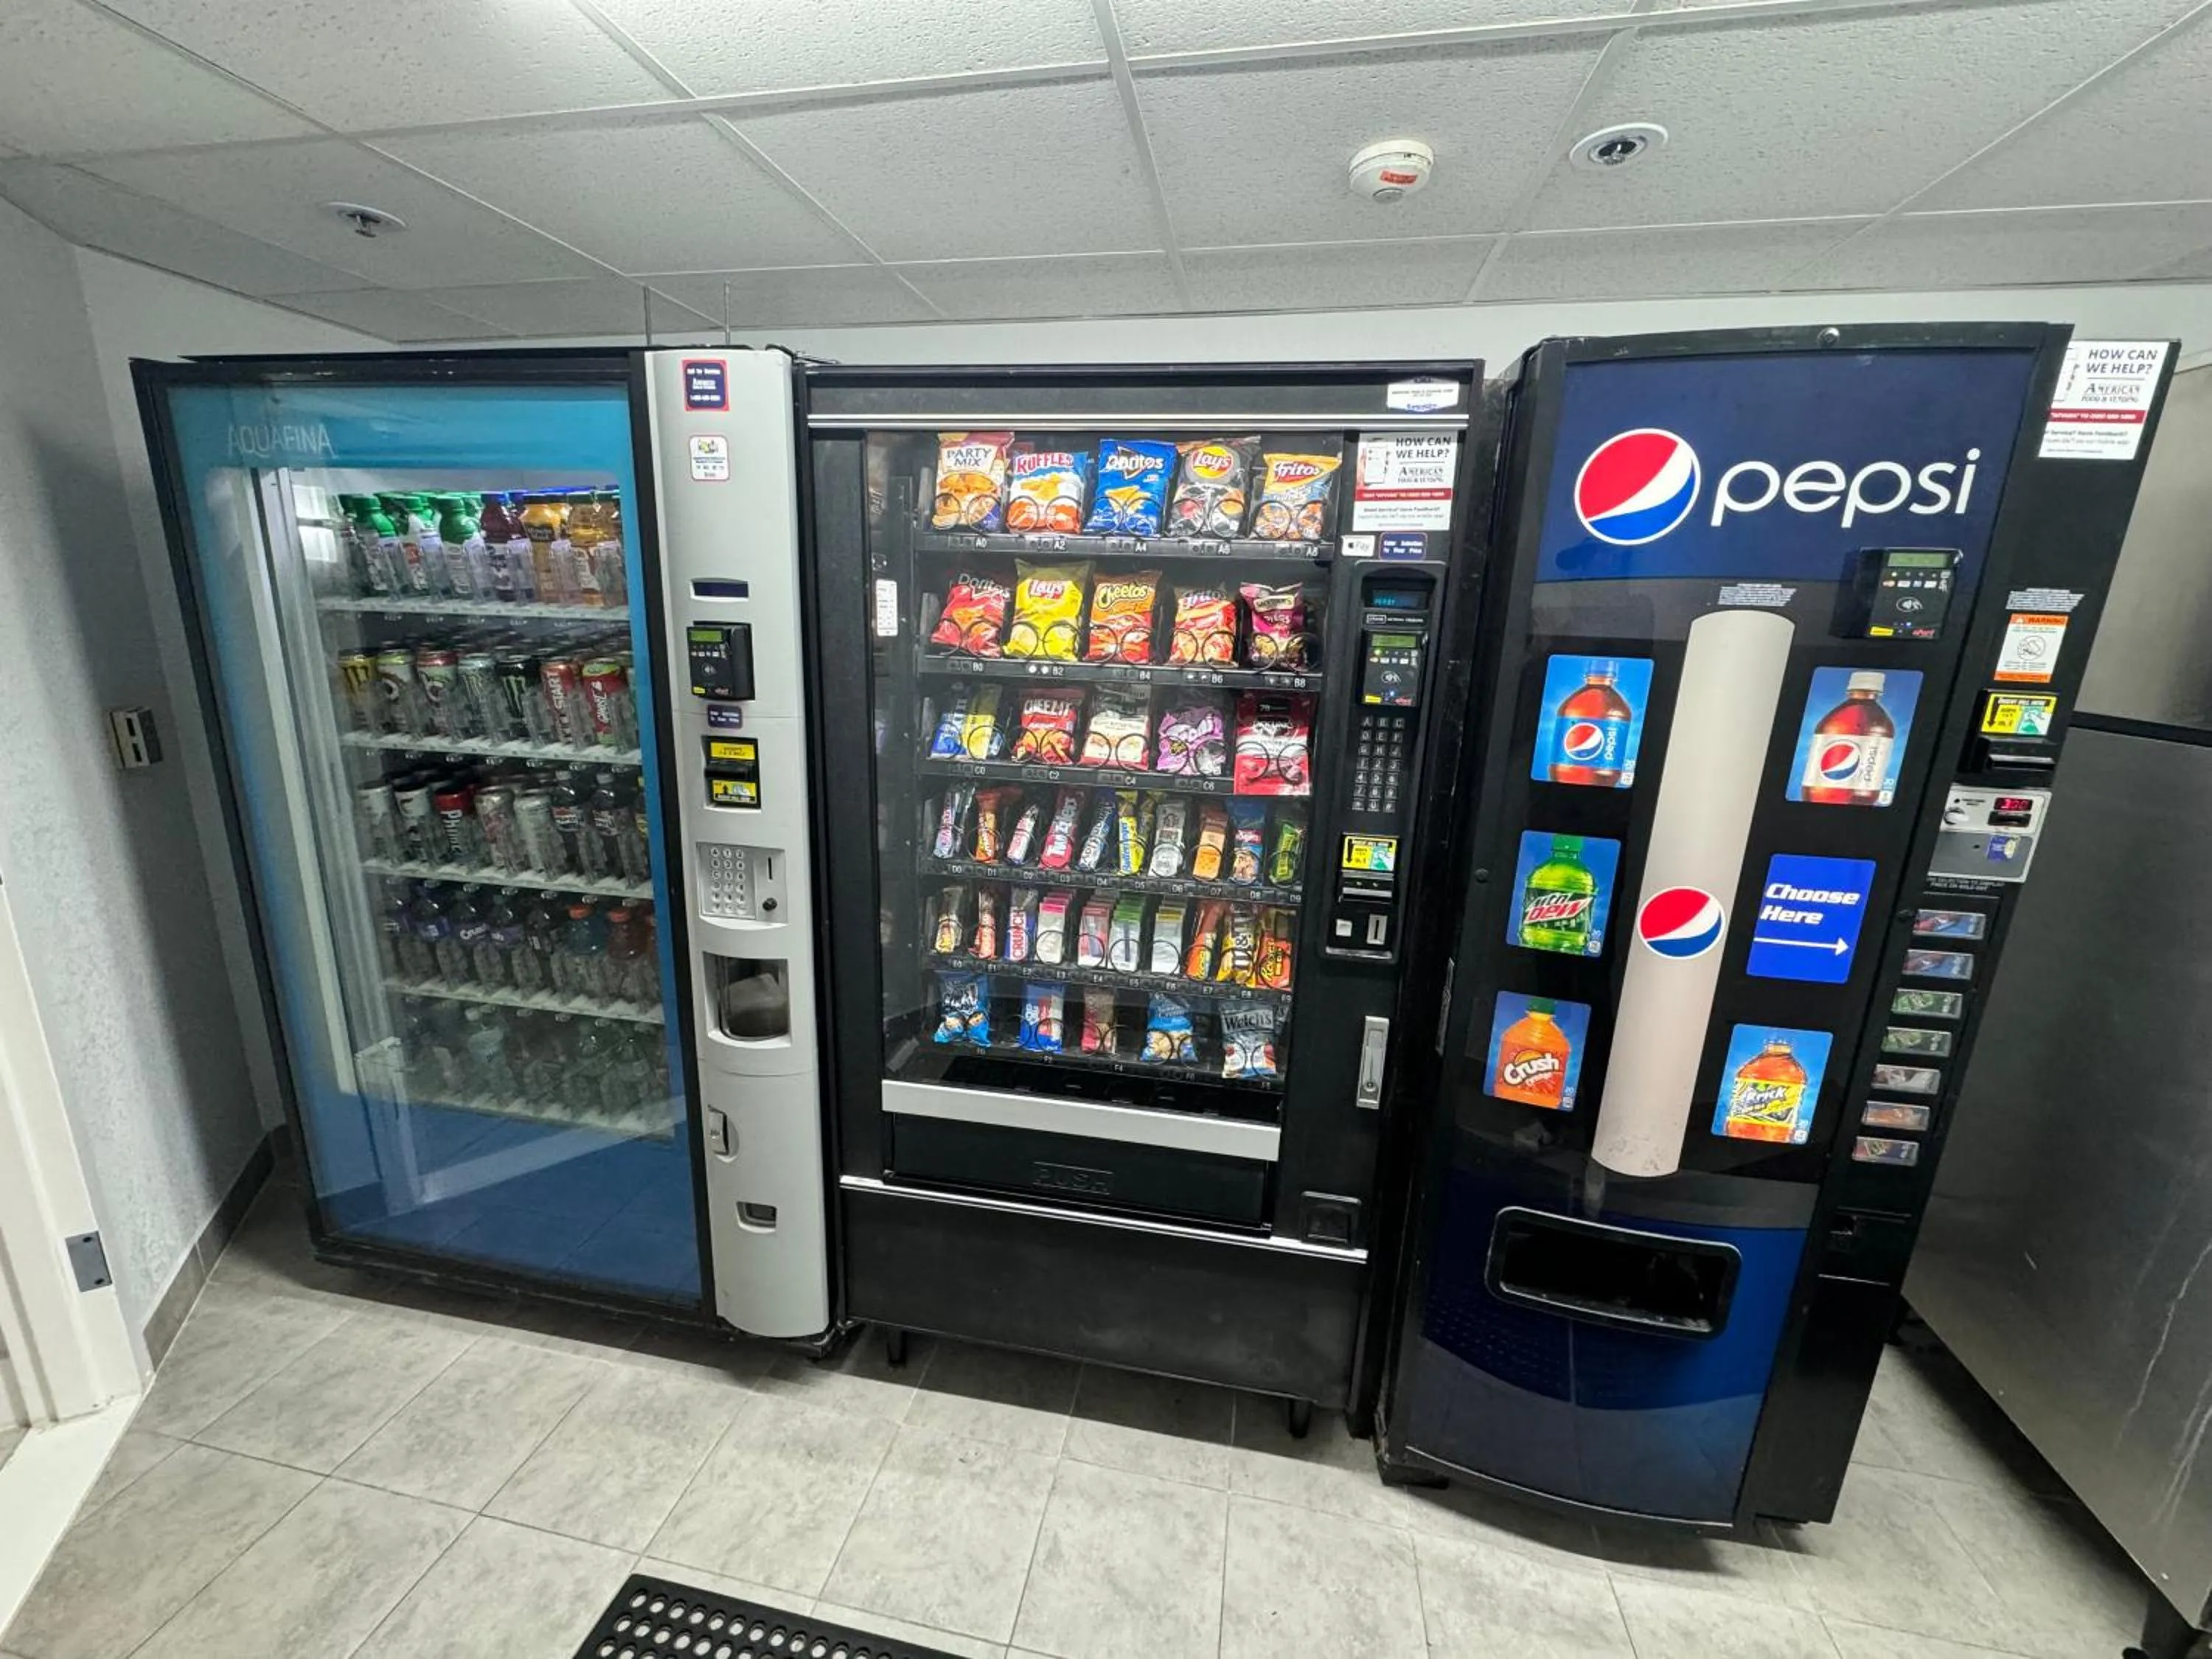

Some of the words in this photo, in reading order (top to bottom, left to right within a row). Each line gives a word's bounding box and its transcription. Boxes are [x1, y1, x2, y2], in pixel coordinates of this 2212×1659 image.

[2088, 349, 2124, 360] HOW
[2128, 349, 2158, 360] CAN
[2086, 364, 2108, 373] WE
[2111, 364, 2153, 375] HELP?
[227, 423, 338, 459] AQUAFINA
[1396, 437, 1424, 447] HOW
[1427, 437, 1451, 446] CAN
[947, 448, 992, 459] PARTY
[1396, 451, 1413, 459] WE
[1416, 449, 1450, 458] HELP?
[953, 458, 981, 467] MIX
[1016, 451, 1074, 473] RUFFLES
[1275, 462, 1320, 478] Fritos
[1710, 448, 1981, 528] pepsi
[975, 537, 987, 548] A0
[1054, 539, 1066, 551] A2
[1135, 542, 1147, 553] A4
[959, 573, 1011, 599] Doritos
[1097, 584, 1149, 608] Cheetos
[1052, 666, 1063, 676] B2
[1139, 671, 1151, 681] B4
[1211, 674, 1223, 684] B6
[1294, 678, 1306, 689] B8
[1604, 727, 1618, 761] pepsi
[1864, 745, 1878, 782] pepsi
[973, 765, 986, 775] C0
[1049, 771, 1060, 780] C2
[1766, 883, 1861, 905] Choose
[1760, 905, 1824, 925] Here
[1012, 906, 1026, 960] CRUNCH
[1222, 1013, 1272, 1031] Welch's
[1503, 1053, 1560, 1085] Crush
